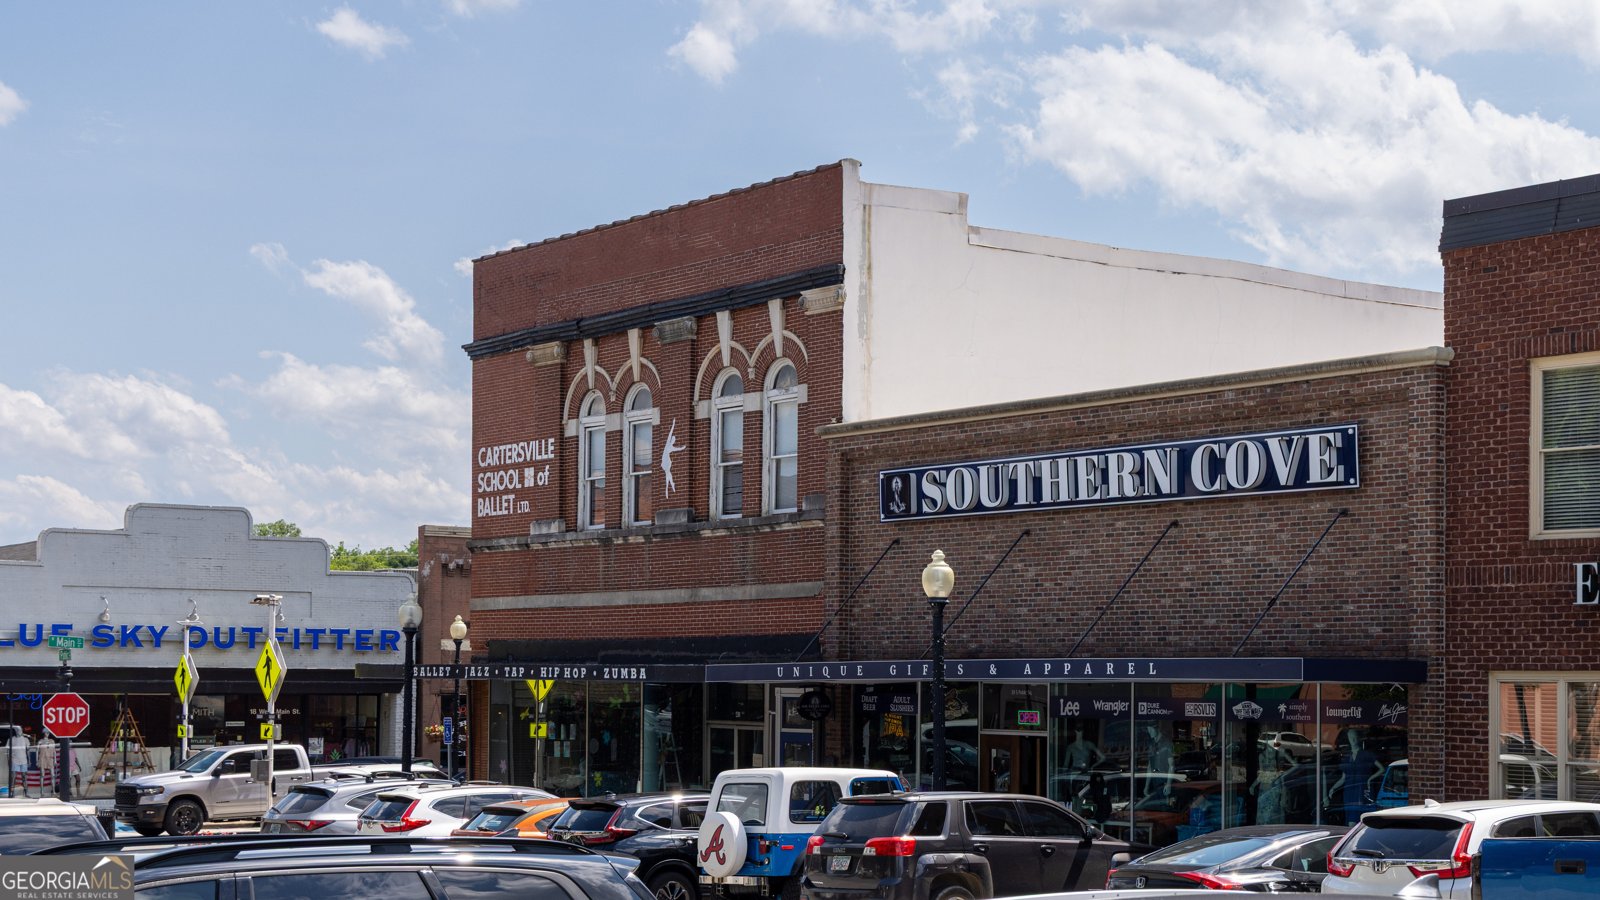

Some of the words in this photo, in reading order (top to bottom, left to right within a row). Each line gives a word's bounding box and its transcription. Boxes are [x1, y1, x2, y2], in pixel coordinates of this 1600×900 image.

[478, 438, 555, 467] CARTERSVILLE
[477, 469, 522, 492] SCHOOL
[537, 465, 549, 486] of
[921, 448, 1180, 513] SOUTHERN
[1190, 433, 1345, 492] COVE
[477, 494, 515, 517] BALLET
[1572, 562, 1599, 605] E
[57, 637, 75, 648] Main
[91, 624, 170, 648] SKY
[412, 666, 451, 677] BALLET
[464, 666, 490, 678] JAZZ
[504, 667, 525, 678] TAP
[603, 668, 647, 679] ZUMBA
[777, 665, 863, 678] UNIQUE
[889, 664, 963, 676] GIFS
[989, 664, 997, 675] &
[1023, 663, 1157, 675] APPAREL
[861, 694, 878, 703] DRAFT
[893, 695, 911, 704] ADULT
[863, 703, 876, 711] BEER
[889, 703, 914, 713] SLUSHIES
[1060, 698, 1080, 716] Lee
[1093, 699, 1130, 717] Wrangler
[1289, 702, 1308, 712] simply
[46, 707, 86, 724] STOP
[1019, 713, 1038, 723] OPEN
[1286, 712, 1311, 721] southern
